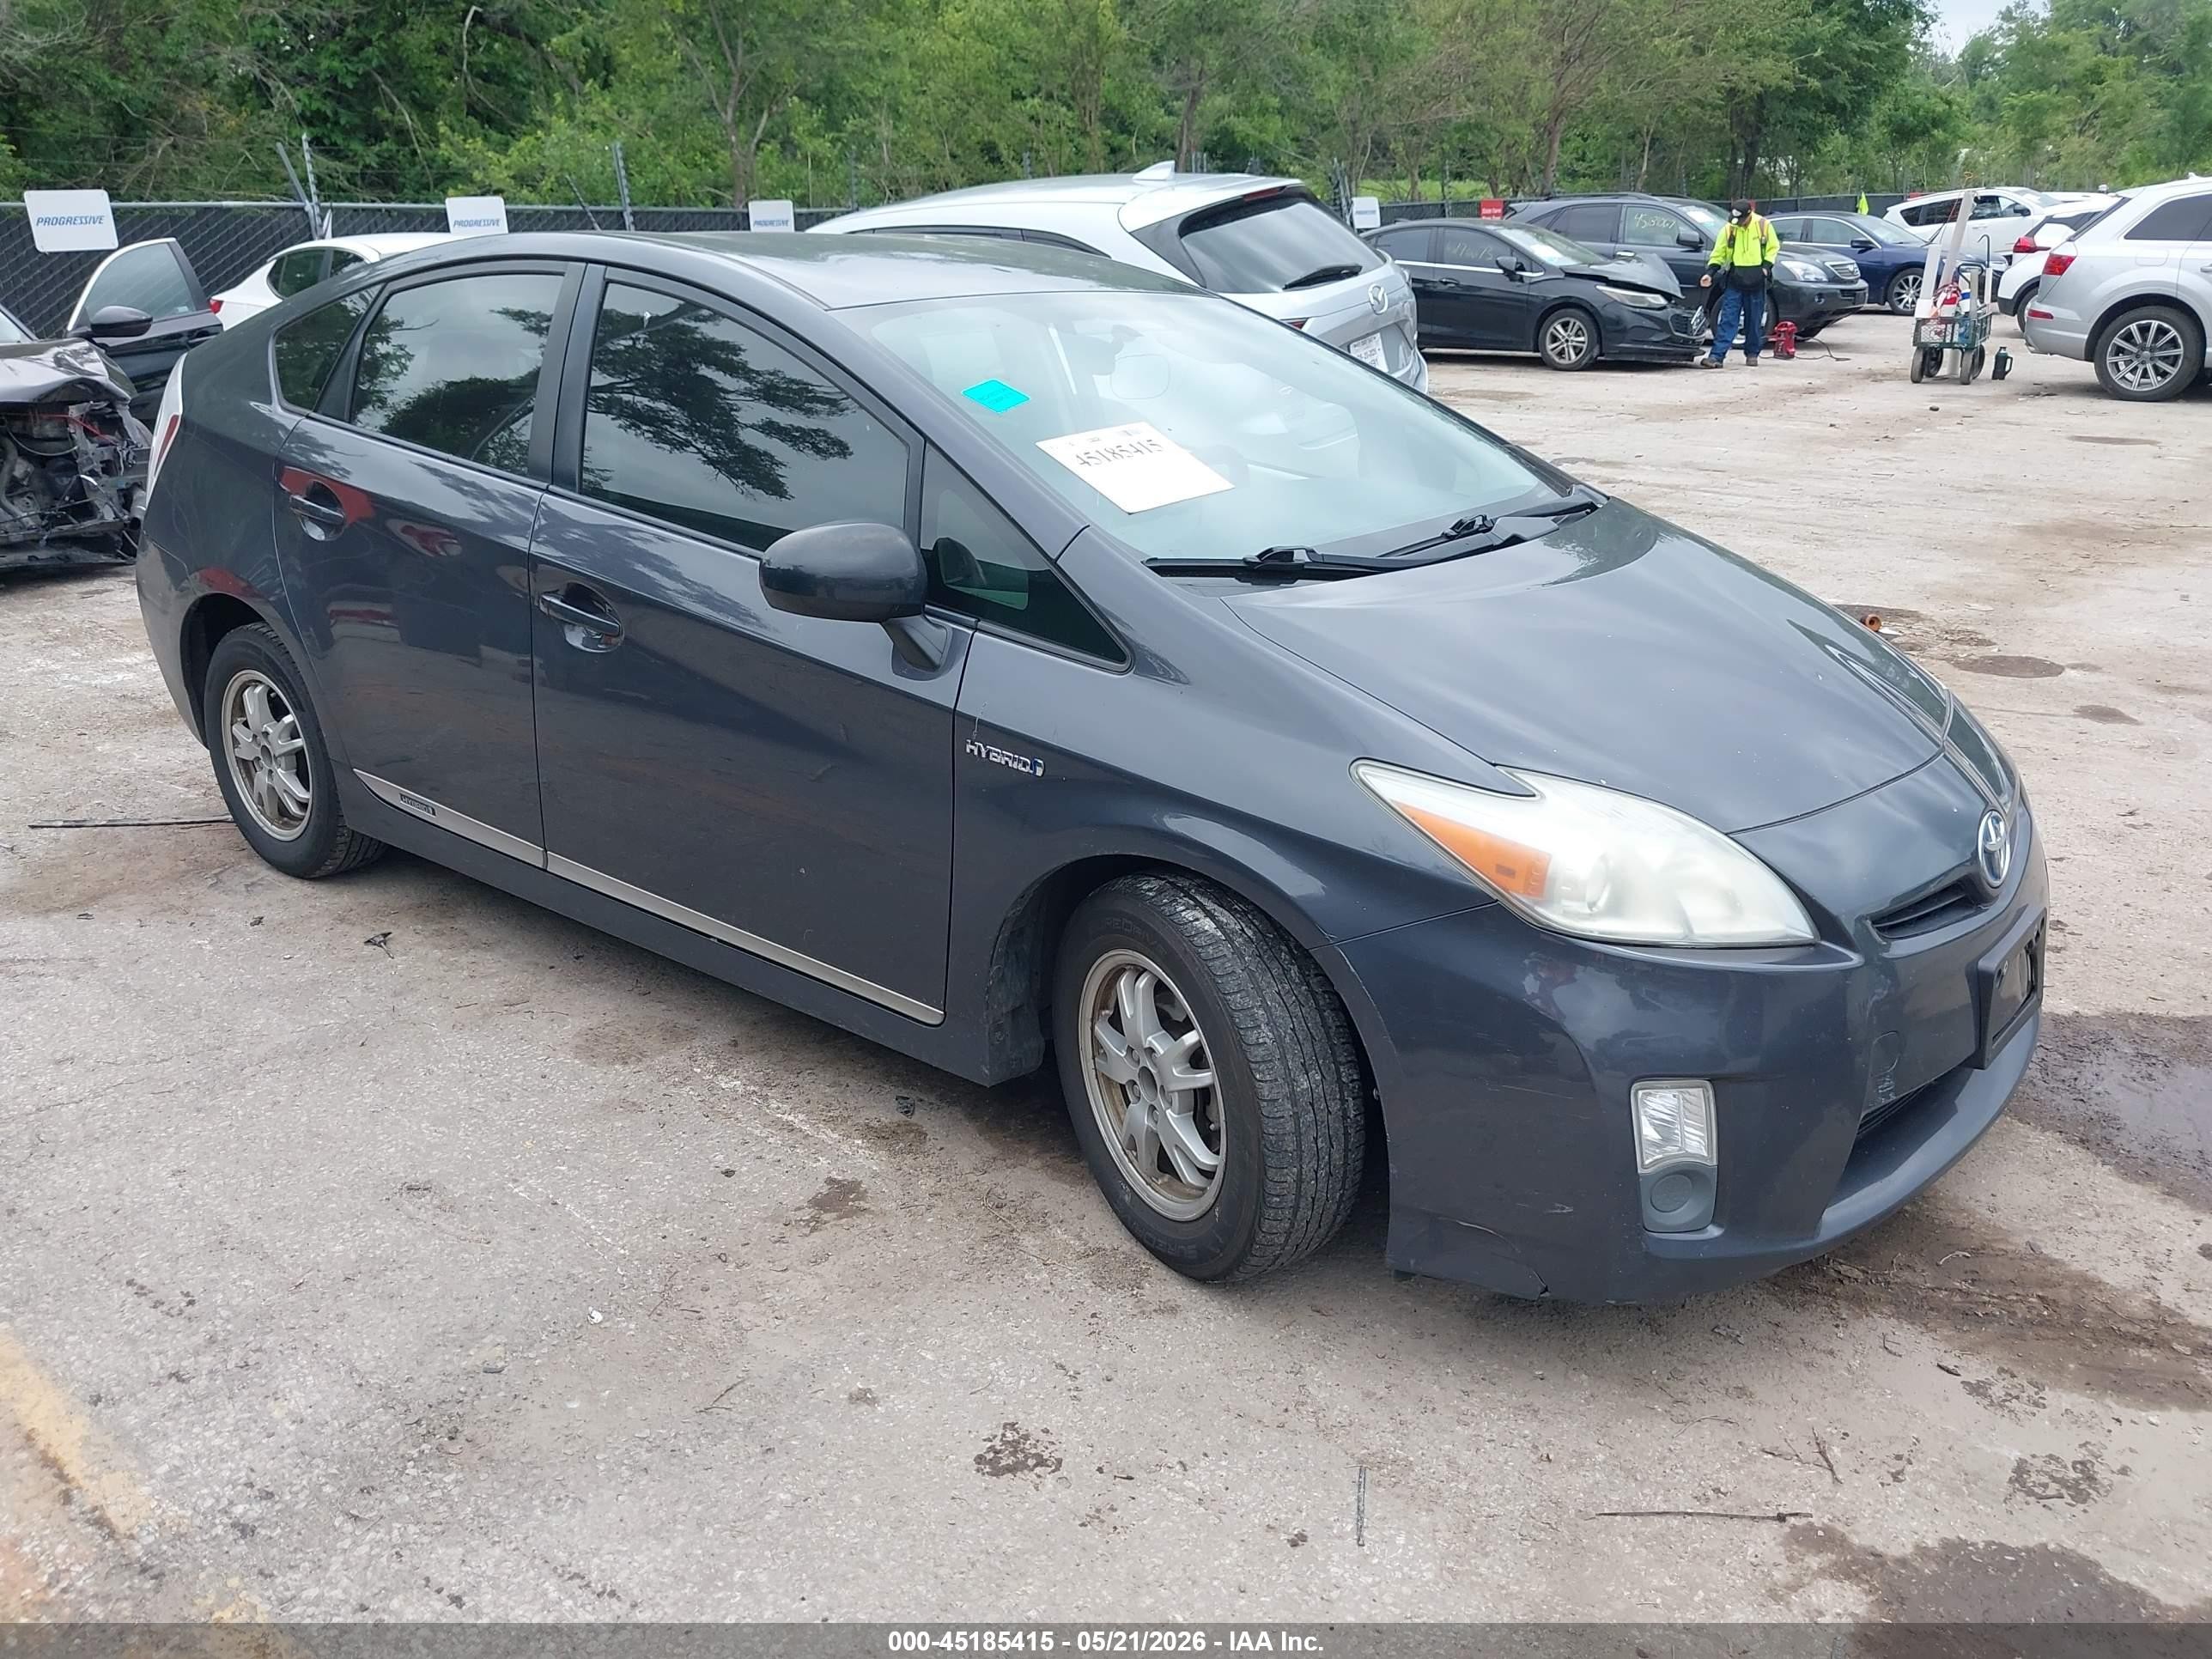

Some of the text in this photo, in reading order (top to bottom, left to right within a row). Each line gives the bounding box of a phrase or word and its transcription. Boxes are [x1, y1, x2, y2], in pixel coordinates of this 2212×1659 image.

[36, 215, 105, 226] PROGRESSIVE
[453, 218, 501, 228] PROGRESSIVE
[1075, 439, 1164, 467] 45185415
[965, 738, 1033, 773] HYBRID
